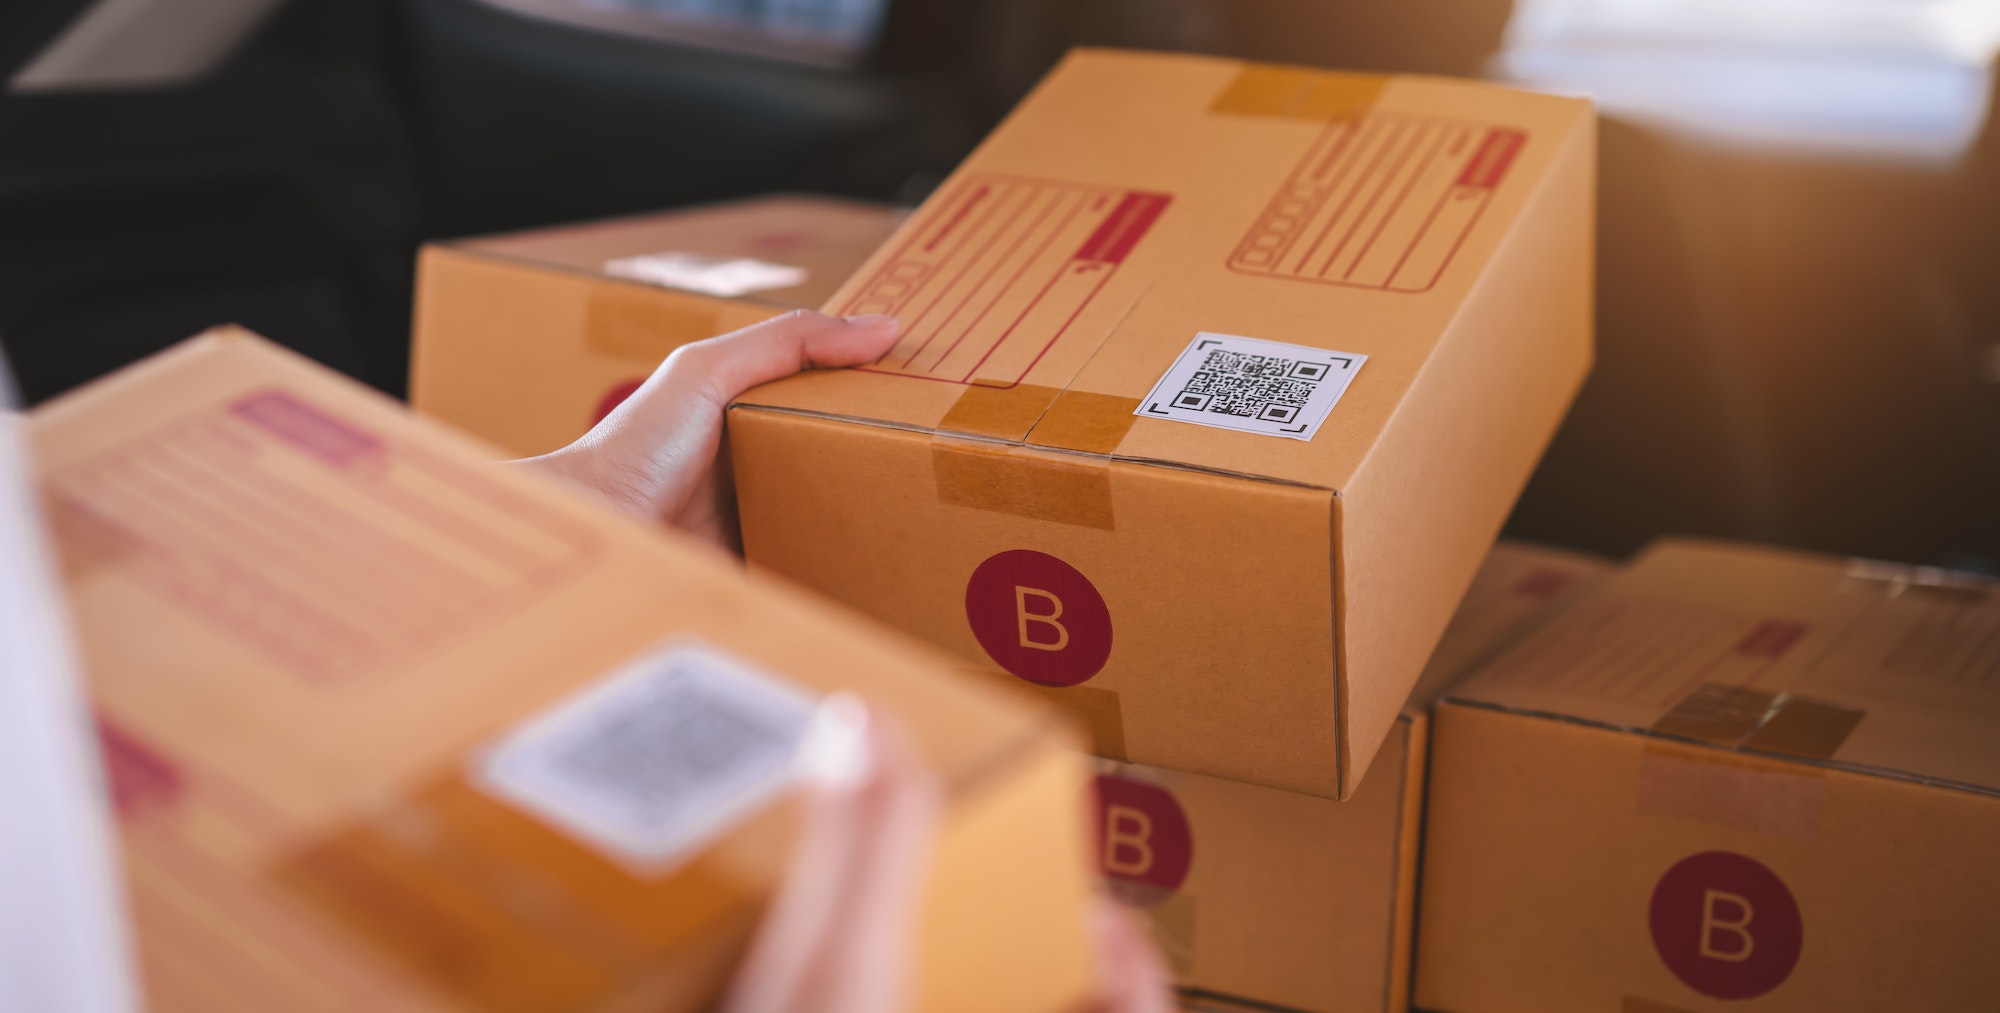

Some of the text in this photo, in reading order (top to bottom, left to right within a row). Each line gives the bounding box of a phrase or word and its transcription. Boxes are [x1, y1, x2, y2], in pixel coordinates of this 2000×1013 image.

[1015, 585, 1069, 651] B
[1105, 804, 1153, 876] B
[1699, 888, 1754, 962] B
